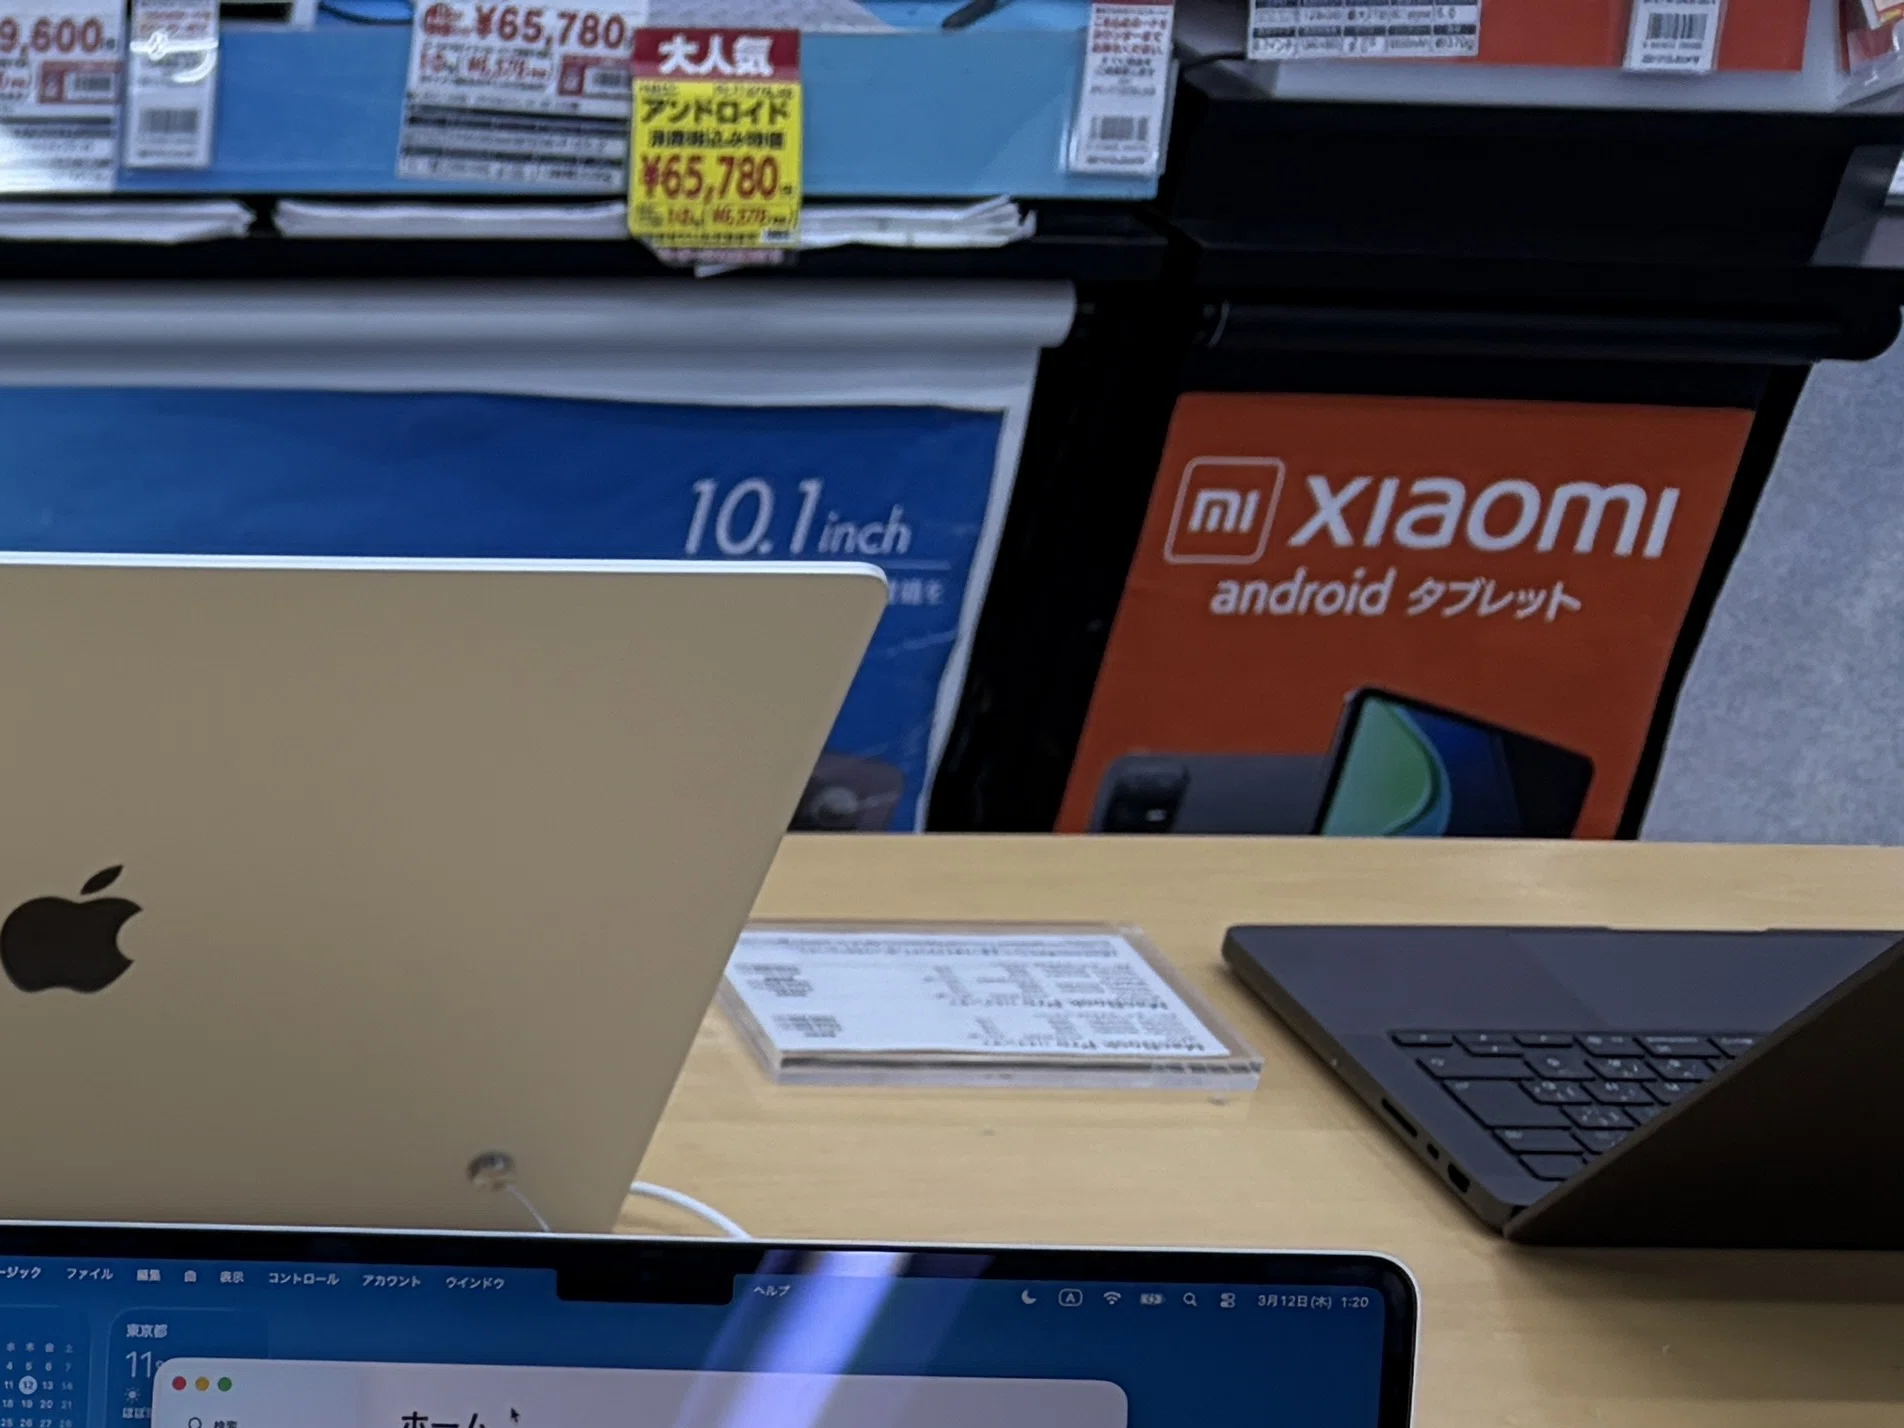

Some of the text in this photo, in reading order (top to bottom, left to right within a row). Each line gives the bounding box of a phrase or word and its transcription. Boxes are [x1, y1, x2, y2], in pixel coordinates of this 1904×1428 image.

[657, 35, 776, 77] 大人気
[639, 98, 792, 126] アンドロイド
[640, 153, 780, 206] ¥65,780
[1209, 566, 1582, 623] android タブレット
[66, 1266, 114, 1281] ファイル
[268, 1271, 341, 1286] コントロール
[362, 1274, 422, 1289] アカウント
[445, 1275, 506, 1290] ウインドウ
[753, 1283, 791, 1297] ヘルプ
[1341, 1295, 1370, 1309] 1:20
[126, 1323, 168, 1338] 東京都
